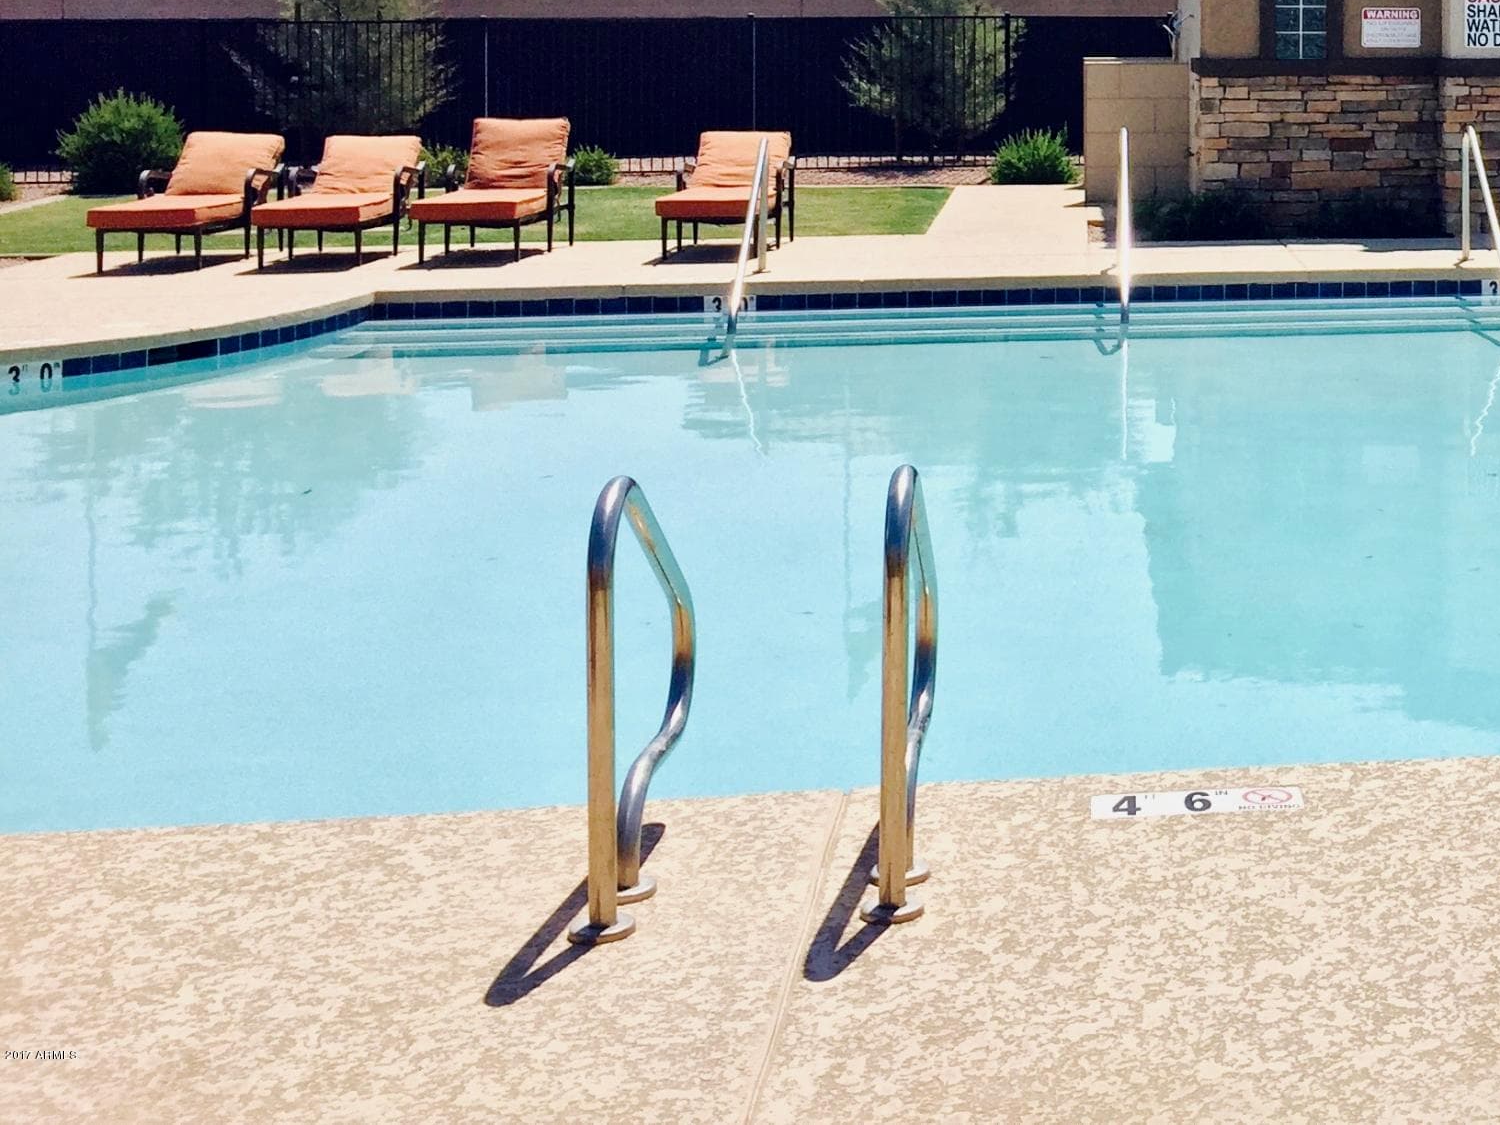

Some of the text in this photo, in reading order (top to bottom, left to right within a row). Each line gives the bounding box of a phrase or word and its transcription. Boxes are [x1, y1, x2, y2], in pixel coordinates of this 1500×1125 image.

[1366, 10, 1418, 19] WARNING
[1467, 33, 1488, 46] NO
[1112, 795, 1142, 816] 4
[1184, 791, 1212, 812] 6
